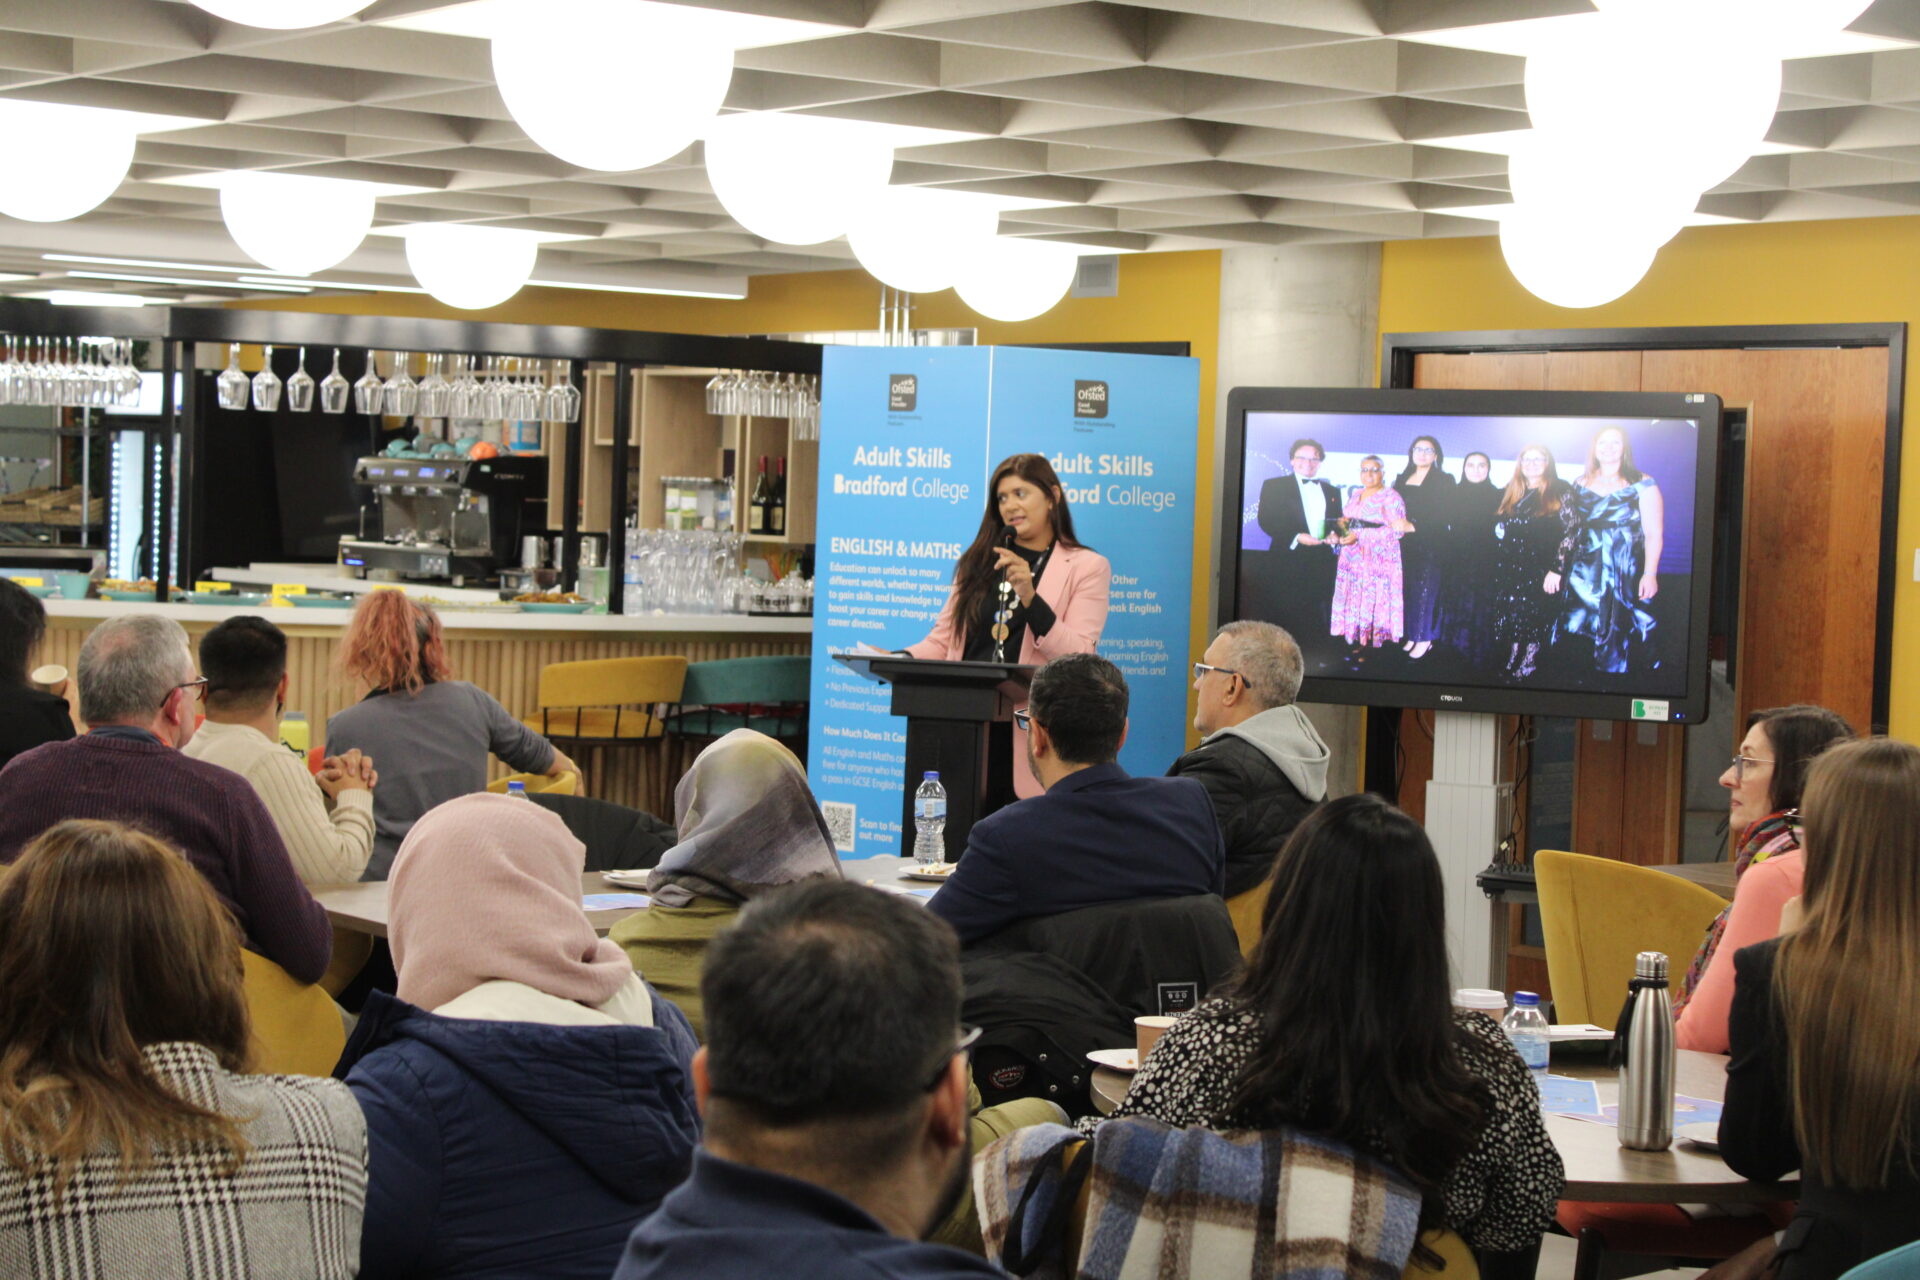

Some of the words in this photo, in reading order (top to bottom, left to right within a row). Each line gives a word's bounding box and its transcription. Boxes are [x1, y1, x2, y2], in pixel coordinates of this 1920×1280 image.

[1078, 390, 1105, 400] Ofsted
[853, 446, 902, 467] Adult
[906, 447, 952, 468] Skills
[1040, 452, 1093, 474] dult
[1098, 454, 1154, 476] Skills
[834, 474, 908, 496] Bradford
[912, 477, 969, 504] College
[1107, 485, 1176, 512] College
[831, 537, 894, 556] ENGLISH
[896, 540, 908, 557] &
[910, 541, 962, 560] MATHS
[830, 562, 866, 574] Education
[868, 566, 880, 574] can
[883, 566, 907, 576] unlock
[909, 568, 918, 576] so
[919, 568, 940, 580] many
[1112, 574, 1138, 584] Other
[829, 576, 860, 586] different
[888, 580, 917, 590] whether
[919, 583, 933, 593] you
[935, 584, 953, 592] wan
[828, 590, 837, 598] to
[838, 592, 854, 601] gain
[856, 592, 874, 601] skills
[875, 593, 890, 602] and
[891, 594, 932, 607] knowledge
[934, 597, 942, 606] to
[1126, 591, 1142, 599] are
[1144, 589, 1157, 599] for
[828, 604, 848, 612] boost
[850, 606, 866, 616] your
[867, 607, 889, 616] career
[900, 608, 928, 621] change
[1129, 603, 1162, 616] English
[828, 618, 849, 627] career
[851, 618, 886, 630] direction.
[1127, 638, 1164, 648] speaking,
[1105, 652, 1140, 663] Learning
[1140, 652, 1168, 664] English
[866, 702, 891, 714] Suppor
[824, 725, 840, 736] How
[842, 727, 861, 738] Much
[863, 730, 882, 740] Does
[884, 732, 891, 742] It
[832, 746, 856, 759] English
[858, 750, 872, 760] and
[873, 752, 894, 762] Maths
[822, 760, 836, 770] free
[837, 760, 846, 770] for
[848, 764, 873, 774] anyone
[875, 765, 889, 776] who
[852, 776, 870, 787] GCSE
[872, 778, 897, 792] English
[860, 818, 878, 830] Scan
[880, 822, 888, 830] to
[859, 832, 872, 840] out
[874, 834, 892, 843] more
